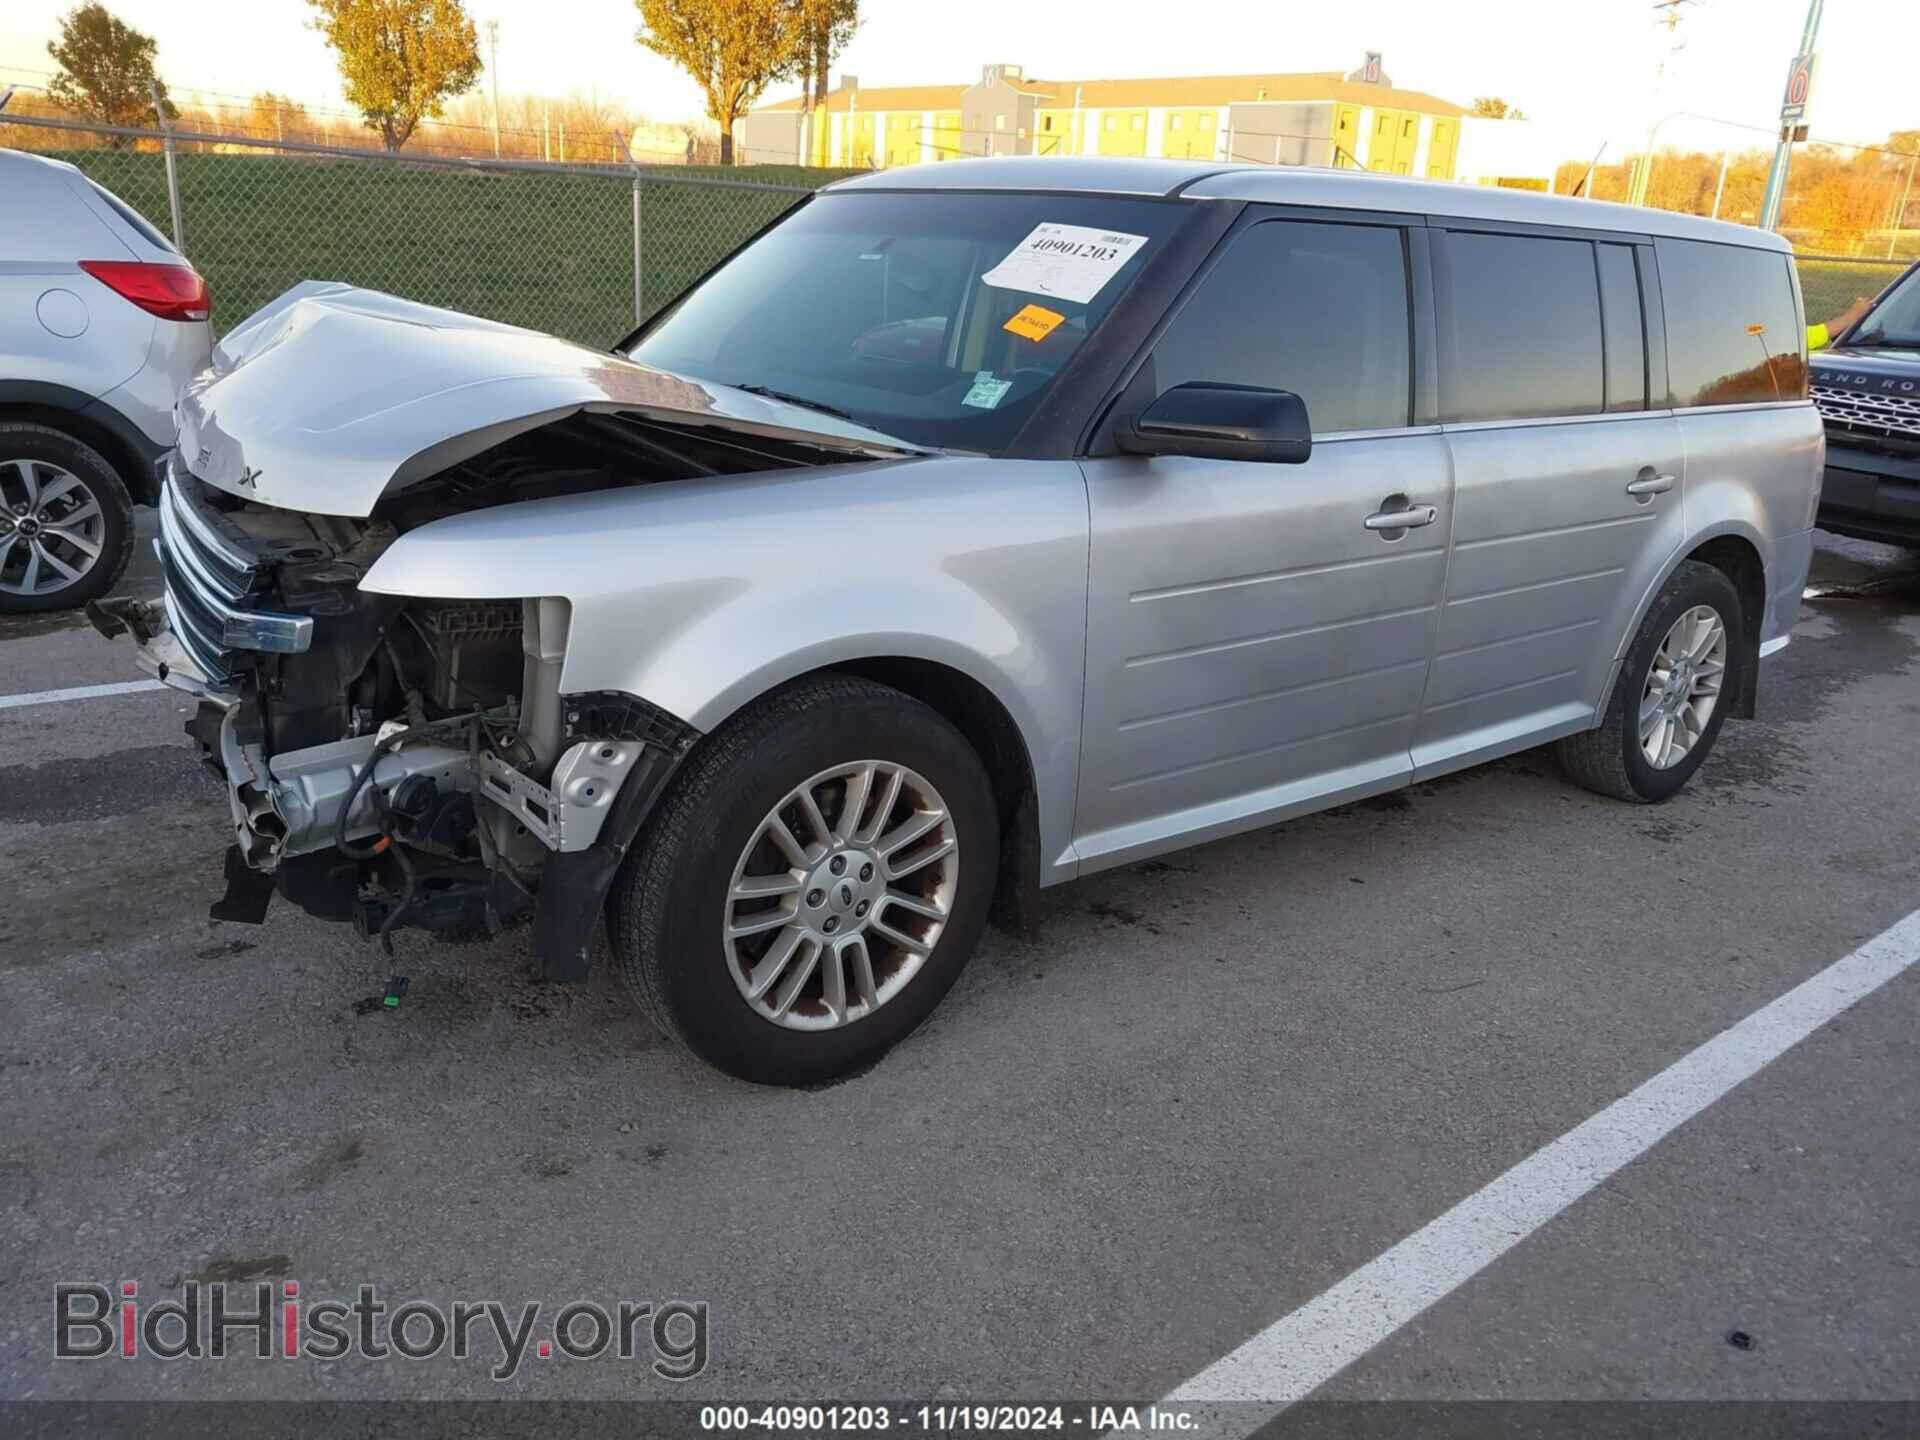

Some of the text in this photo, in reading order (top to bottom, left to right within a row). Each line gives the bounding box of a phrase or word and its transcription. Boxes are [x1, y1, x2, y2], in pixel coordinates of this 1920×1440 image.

[1788, 57, 1808, 104] 6
[1031, 239, 1118, 261] 40901203
[1808, 372, 1867, 385] AND
